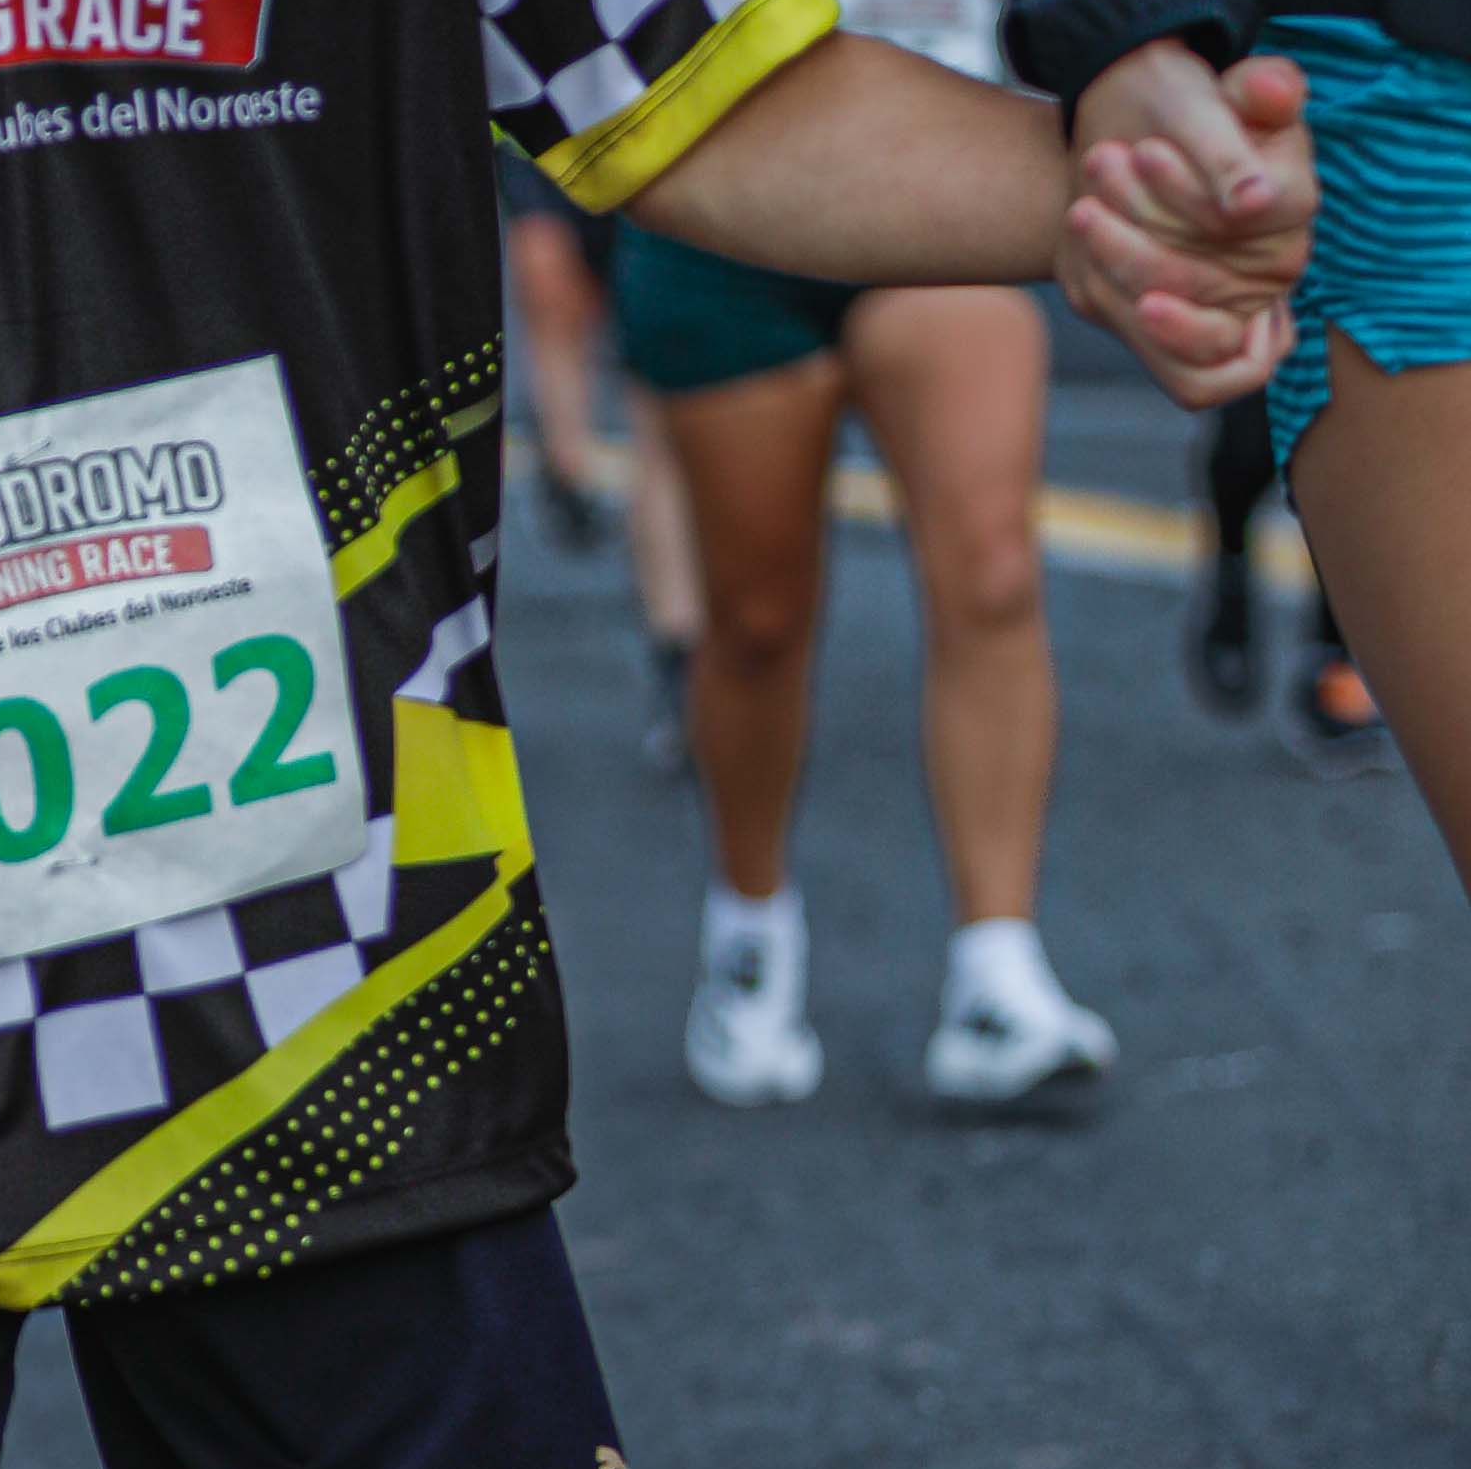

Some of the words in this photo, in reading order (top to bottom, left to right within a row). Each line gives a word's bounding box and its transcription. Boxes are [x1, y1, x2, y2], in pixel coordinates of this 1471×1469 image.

[80, 87, 149, 138] del
[79, 533, 177, 582] RACE
[7, 624, 43, 649] los
[44, 608, 118, 640] Clubes
[122, 593, 155, 623] del
[156, 577, 253, 611] Noroeste
